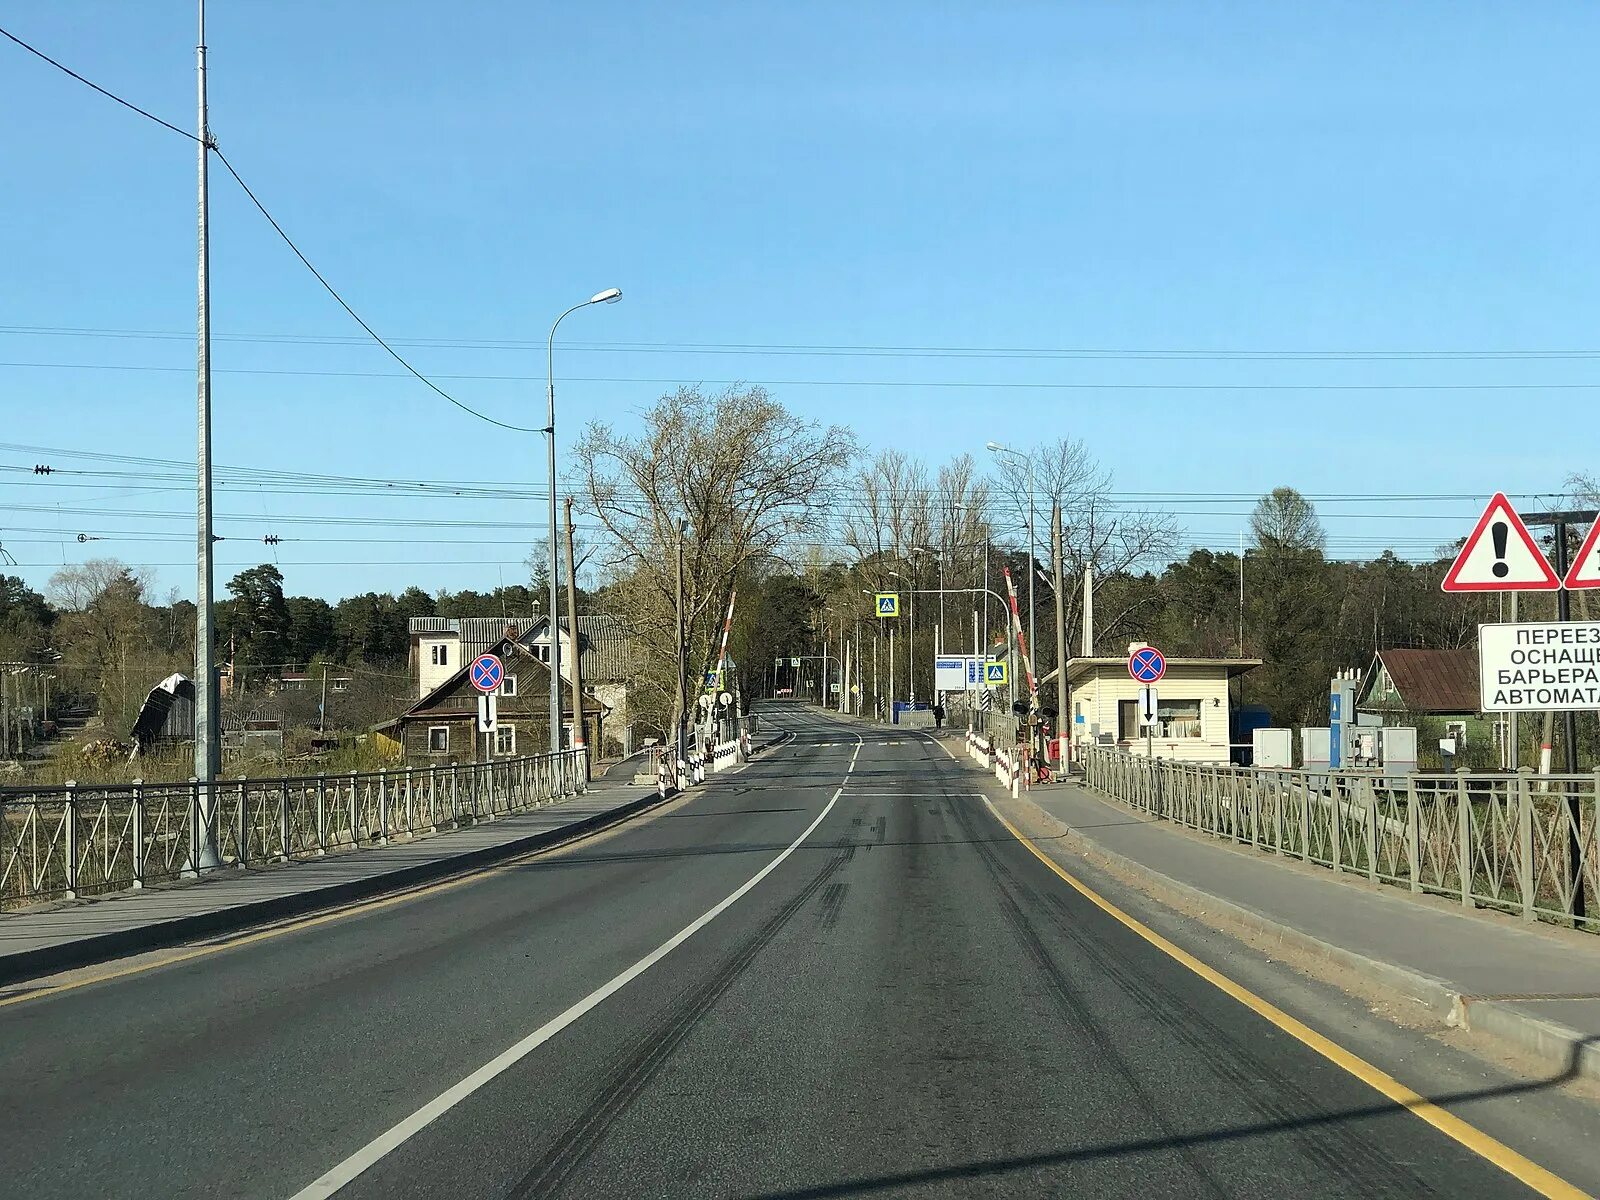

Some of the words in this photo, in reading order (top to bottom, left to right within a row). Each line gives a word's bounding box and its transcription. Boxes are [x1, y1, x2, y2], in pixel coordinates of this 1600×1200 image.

[1516, 628, 1600, 645] ПЕРЕЕЗ
[1510, 648, 1600, 666] ОСНАЩ
[1498, 668, 1599, 685] БАРЬЕРА
[1493, 688, 1600, 704] АВТОМАТ
